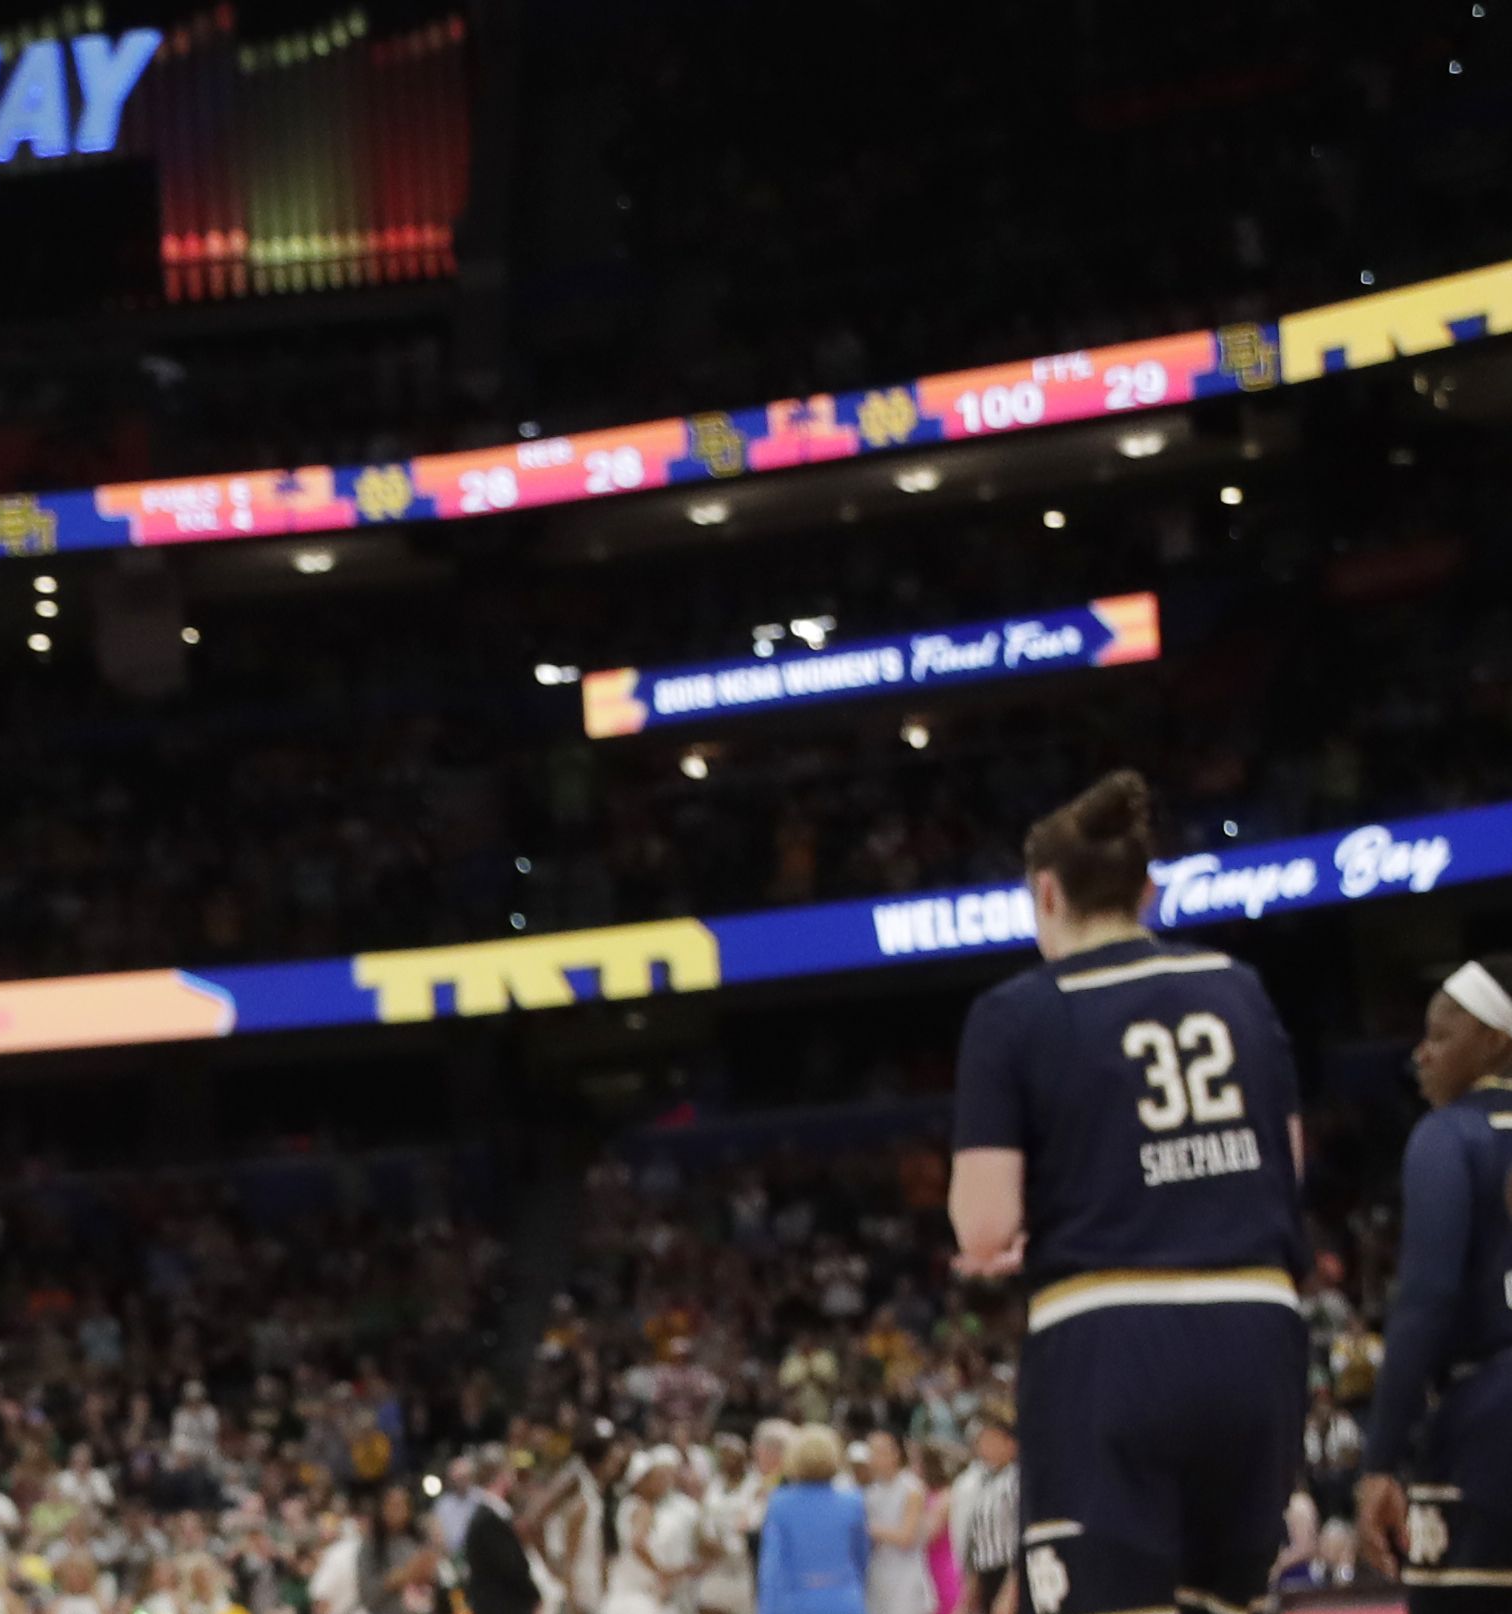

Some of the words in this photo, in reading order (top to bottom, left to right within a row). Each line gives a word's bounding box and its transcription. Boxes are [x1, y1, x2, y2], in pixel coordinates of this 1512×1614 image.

[955, 380, 1044, 433] 100
[1104, 360, 1168, 410] 29
[910, 630, 1000, 682] Final
[1003, 620, 1083, 669] Four
[1148, 853, 1317, 927] Tampa
[1333, 825, 1452, 898] Bay
[1122, 1012, 1245, 1132] 32
[1139, 1128, 1262, 1187] SHEPARD
